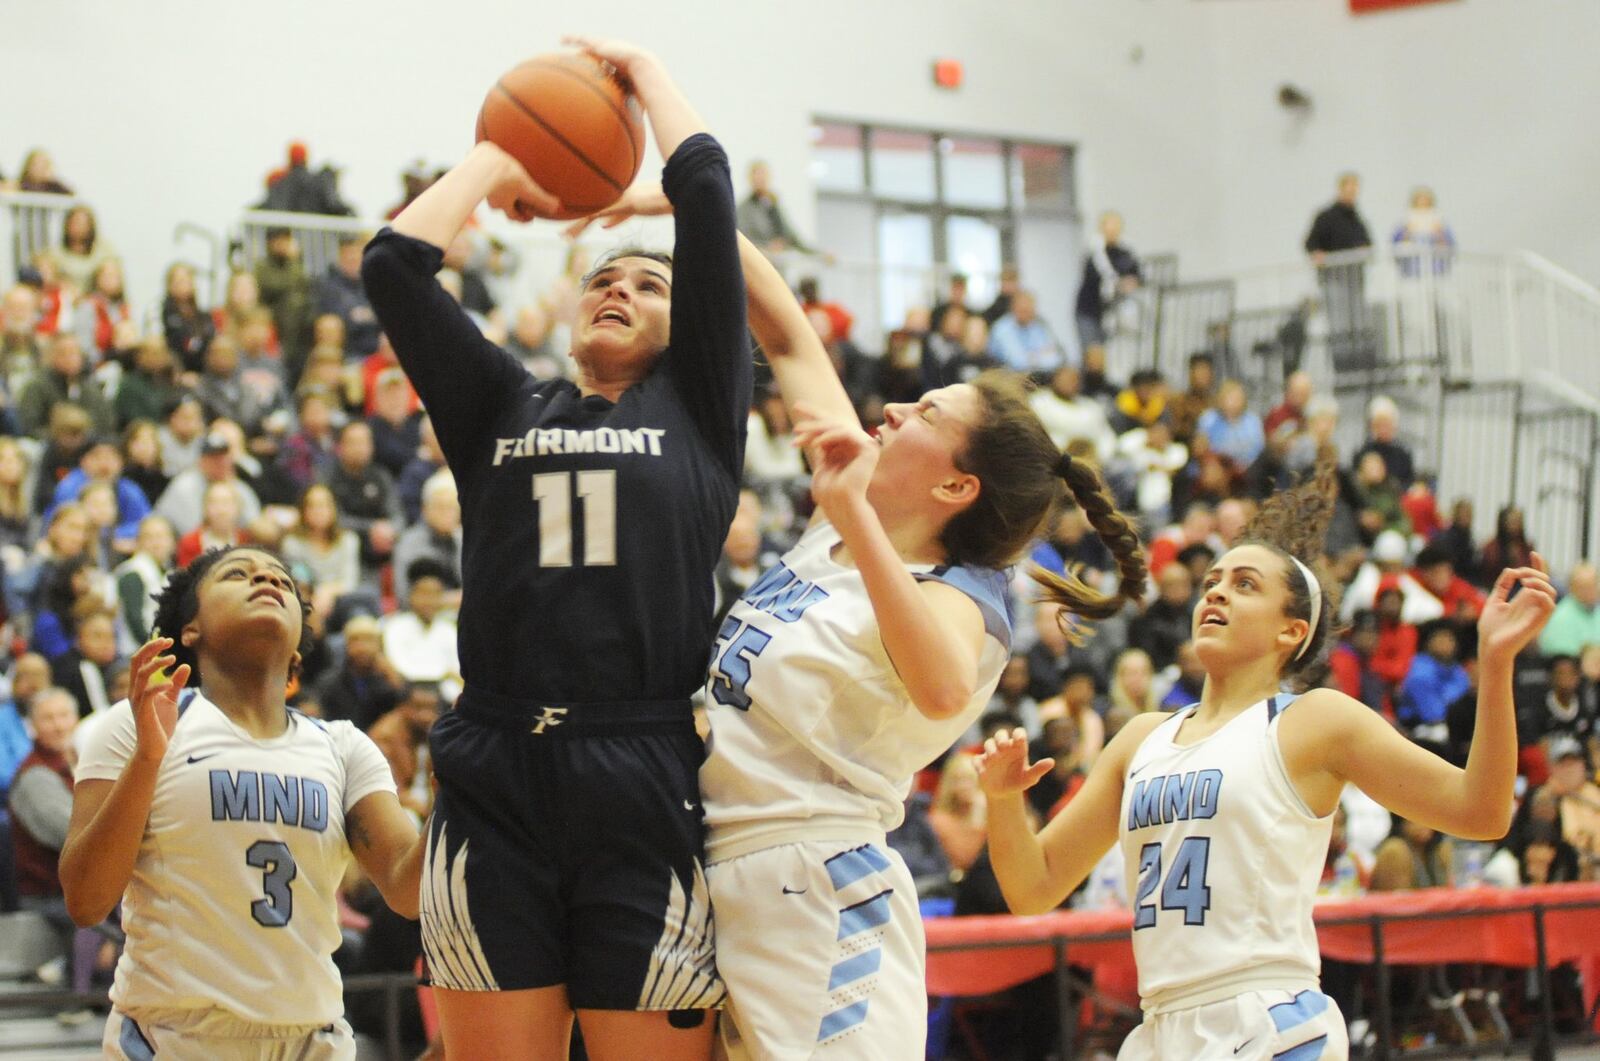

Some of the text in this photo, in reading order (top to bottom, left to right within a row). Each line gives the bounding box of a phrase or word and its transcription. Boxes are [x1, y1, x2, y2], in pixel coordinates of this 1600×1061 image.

[532, 469, 617, 567] 11
[209, 769, 328, 833] MND
[1128, 769, 1223, 831] MND
[246, 839, 297, 927] 3
[1134, 836, 1211, 931] 24
